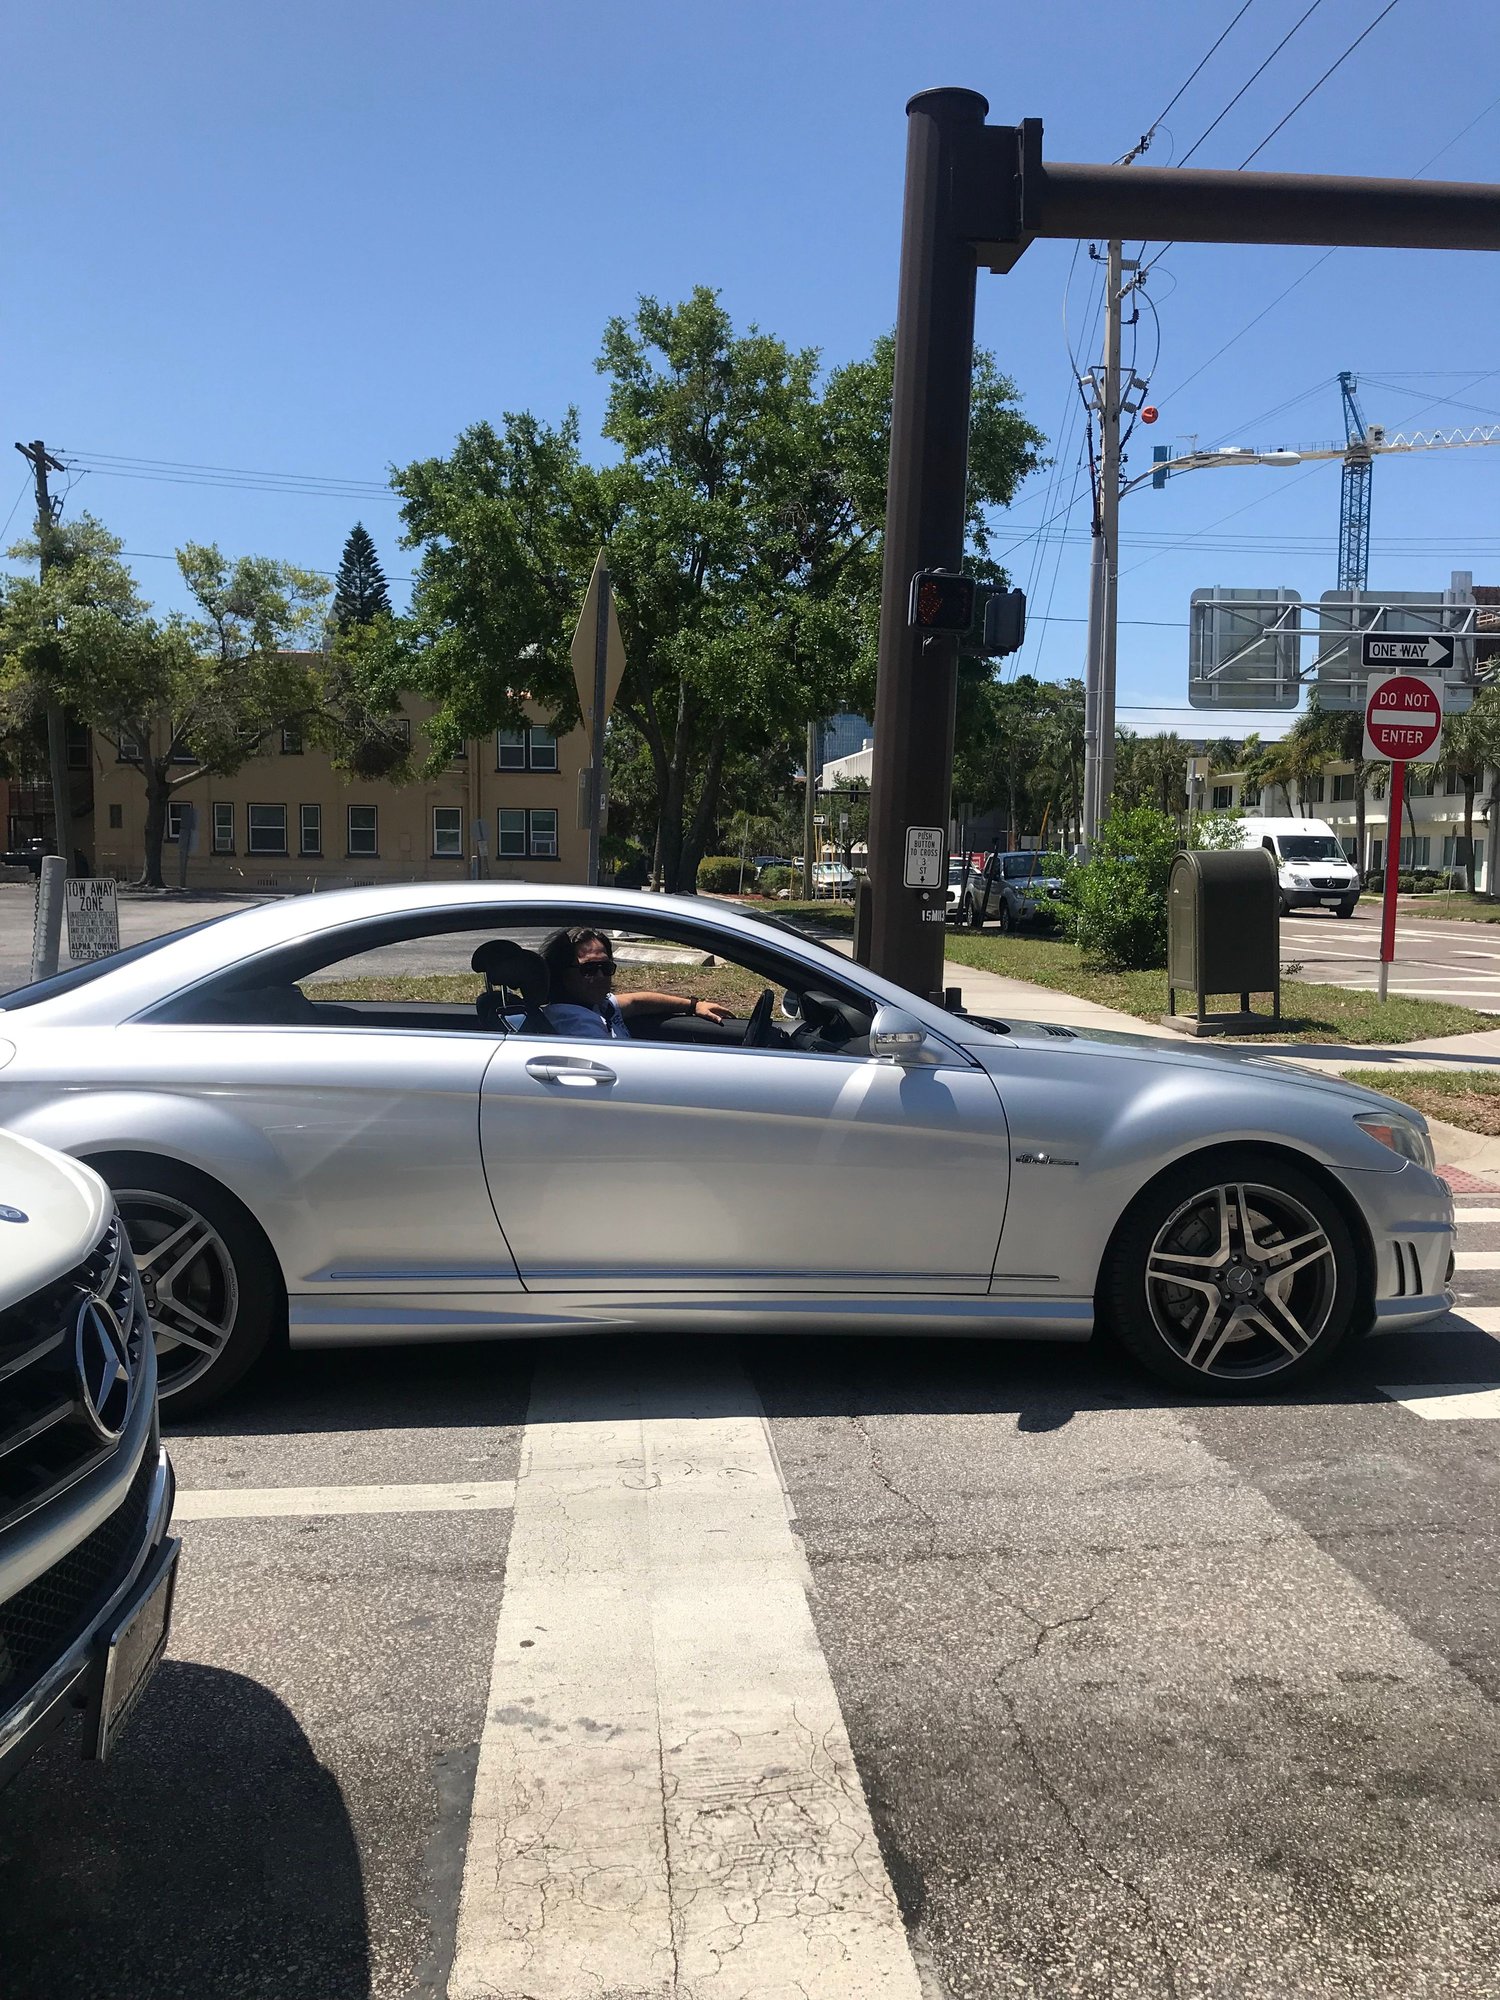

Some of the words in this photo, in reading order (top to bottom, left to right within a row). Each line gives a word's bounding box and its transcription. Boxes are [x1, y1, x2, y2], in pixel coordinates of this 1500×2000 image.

[1372, 643, 1397, 657] ONE
[1401, 644, 1427, 658] WAY
[1379, 692, 1397, 706] DO
[1404, 693, 1430, 707] NOT
[1381, 729, 1424, 744] ENTER
[917, 832, 933, 840] PUSH
[913, 840, 935, 848] BUTTON
[910, 848, 918, 856] TO
[920, 848, 938, 857] CROSS
[919, 866, 927, 875] ST
[67, 881, 86, 897] TOW
[90, 881, 113, 897] AWAY
[80, 896, 104, 911] ZONE
[71, 942, 91, 950] ALPHA
[93, 942, 118, 951] TOWING
